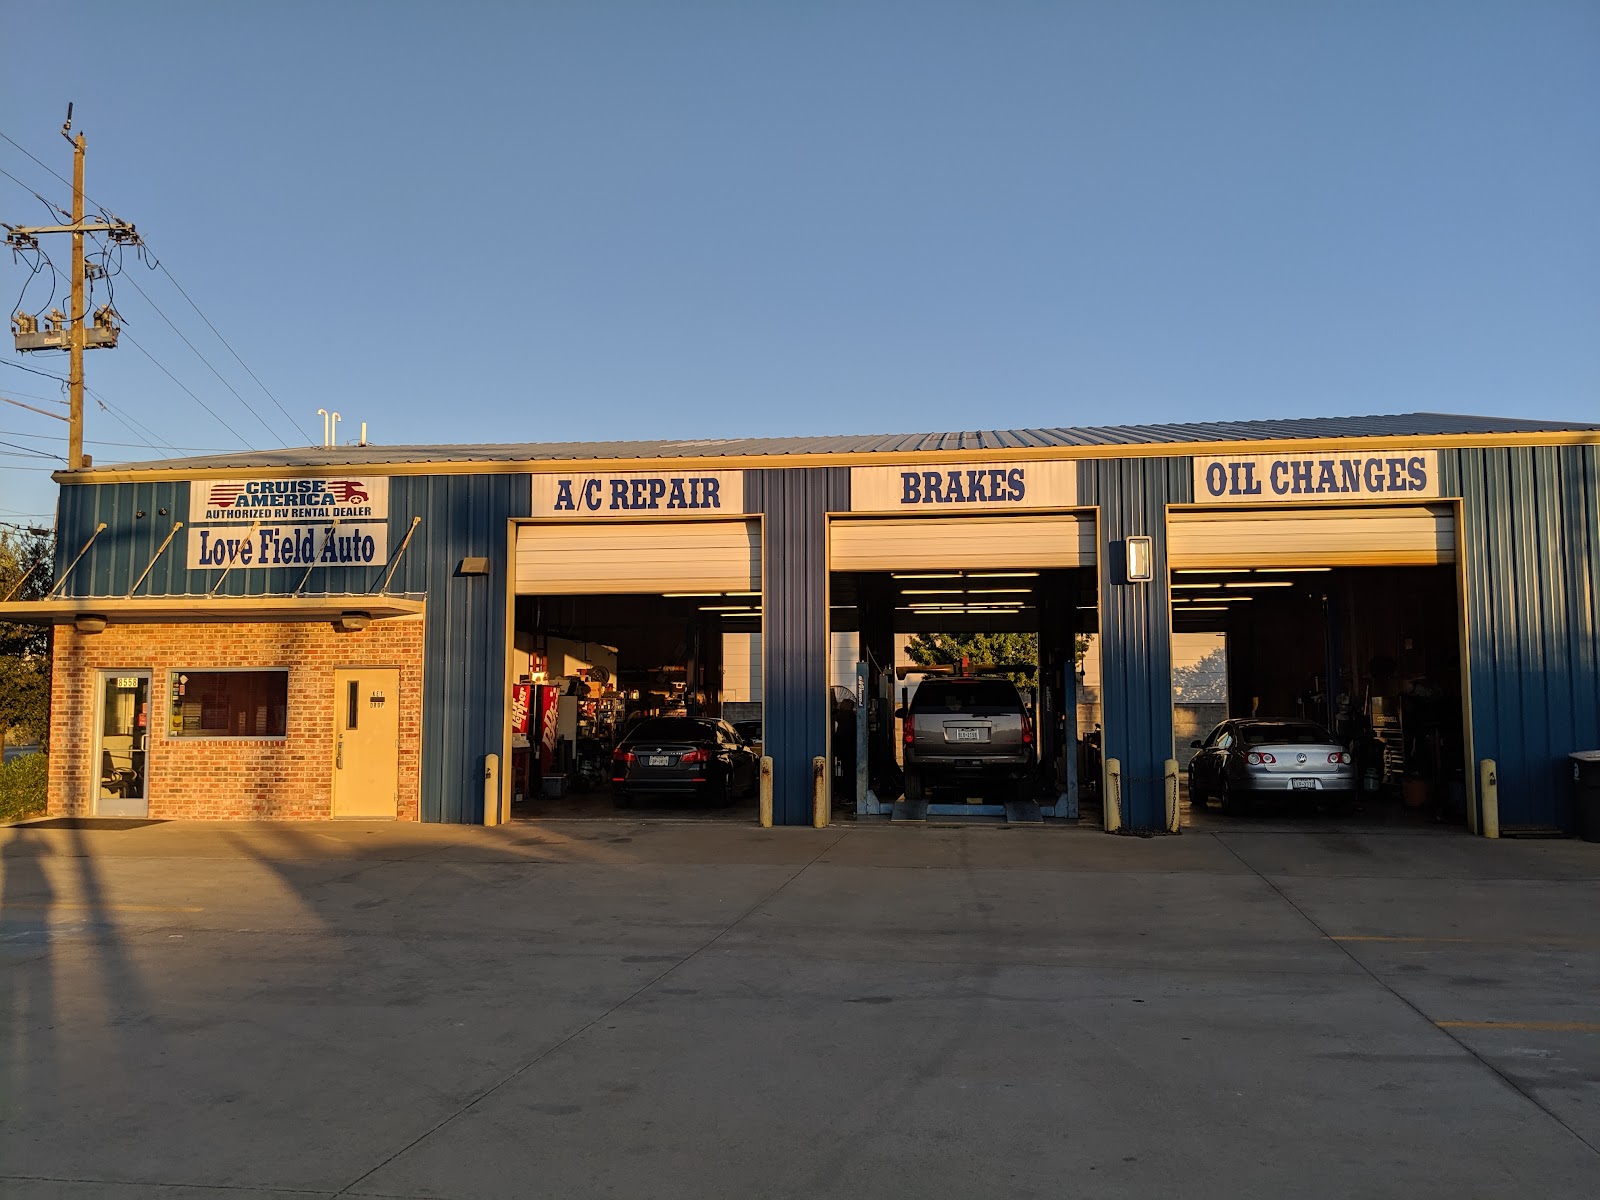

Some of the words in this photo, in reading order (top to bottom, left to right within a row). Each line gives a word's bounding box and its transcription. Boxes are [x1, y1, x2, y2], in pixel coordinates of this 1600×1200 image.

[245, 480, 327, 494] CRUISE
[900, 468, 1026, 504] BRAKES
[1206, 461, 1262, 496] OIL
[1269, 457, 1427, 495] CHANGES
[235, 493, 336, 507] AMERICA
[554, 478, 602, 511] A/C
[609, 477, 721, 510] REPAIR
[205, 508, 272, 519] AUTHORIZED
[274, 508, 289, 518] RV
[291, 507, 331, 518] RENTAL
[333, 506, 371, 517] DEALER
[199, 530, 252, 566] Love
[258, 528, 315, 565] Field
[320, 527, 375, 564] Auto
[118, 678, 138, 687] 8558
